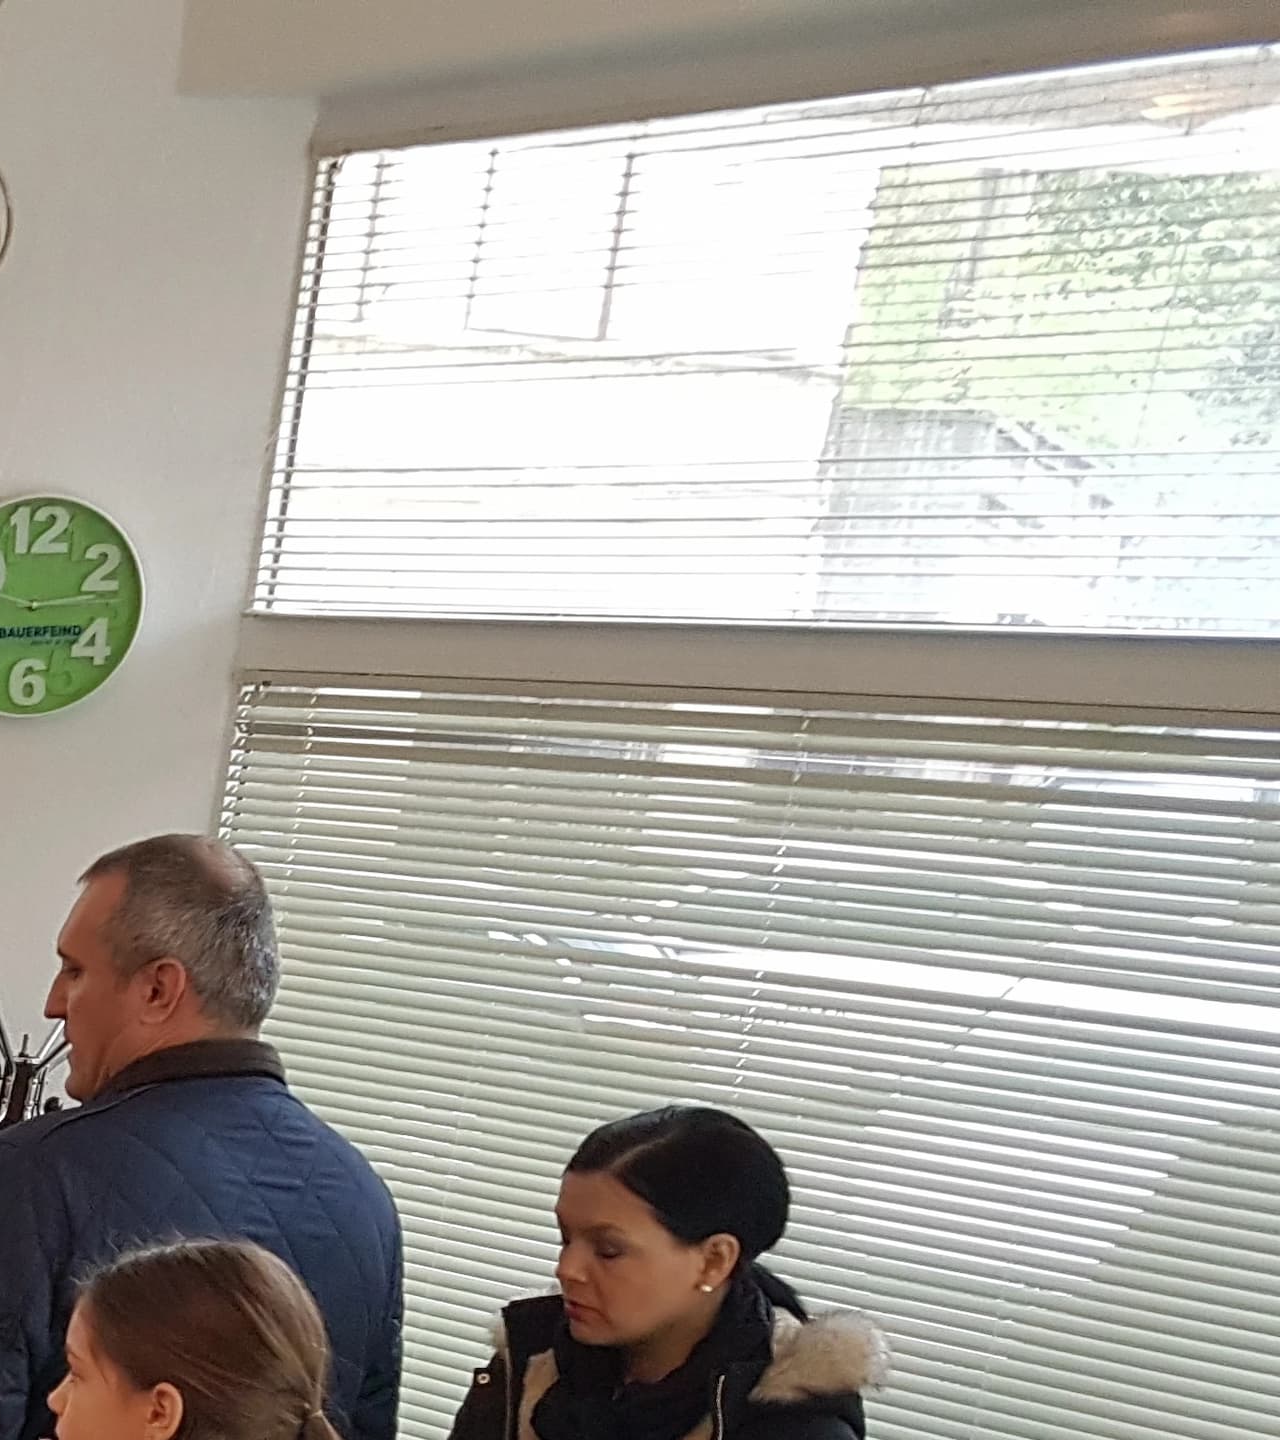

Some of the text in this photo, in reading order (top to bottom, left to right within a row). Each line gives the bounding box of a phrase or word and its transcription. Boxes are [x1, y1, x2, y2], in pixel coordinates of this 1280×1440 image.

[10, 506, 71, 554] 12
[81, 543, 122, 591] 2
[70, 617, 111, 666] 4
[9, 658, 47, 706] 6
